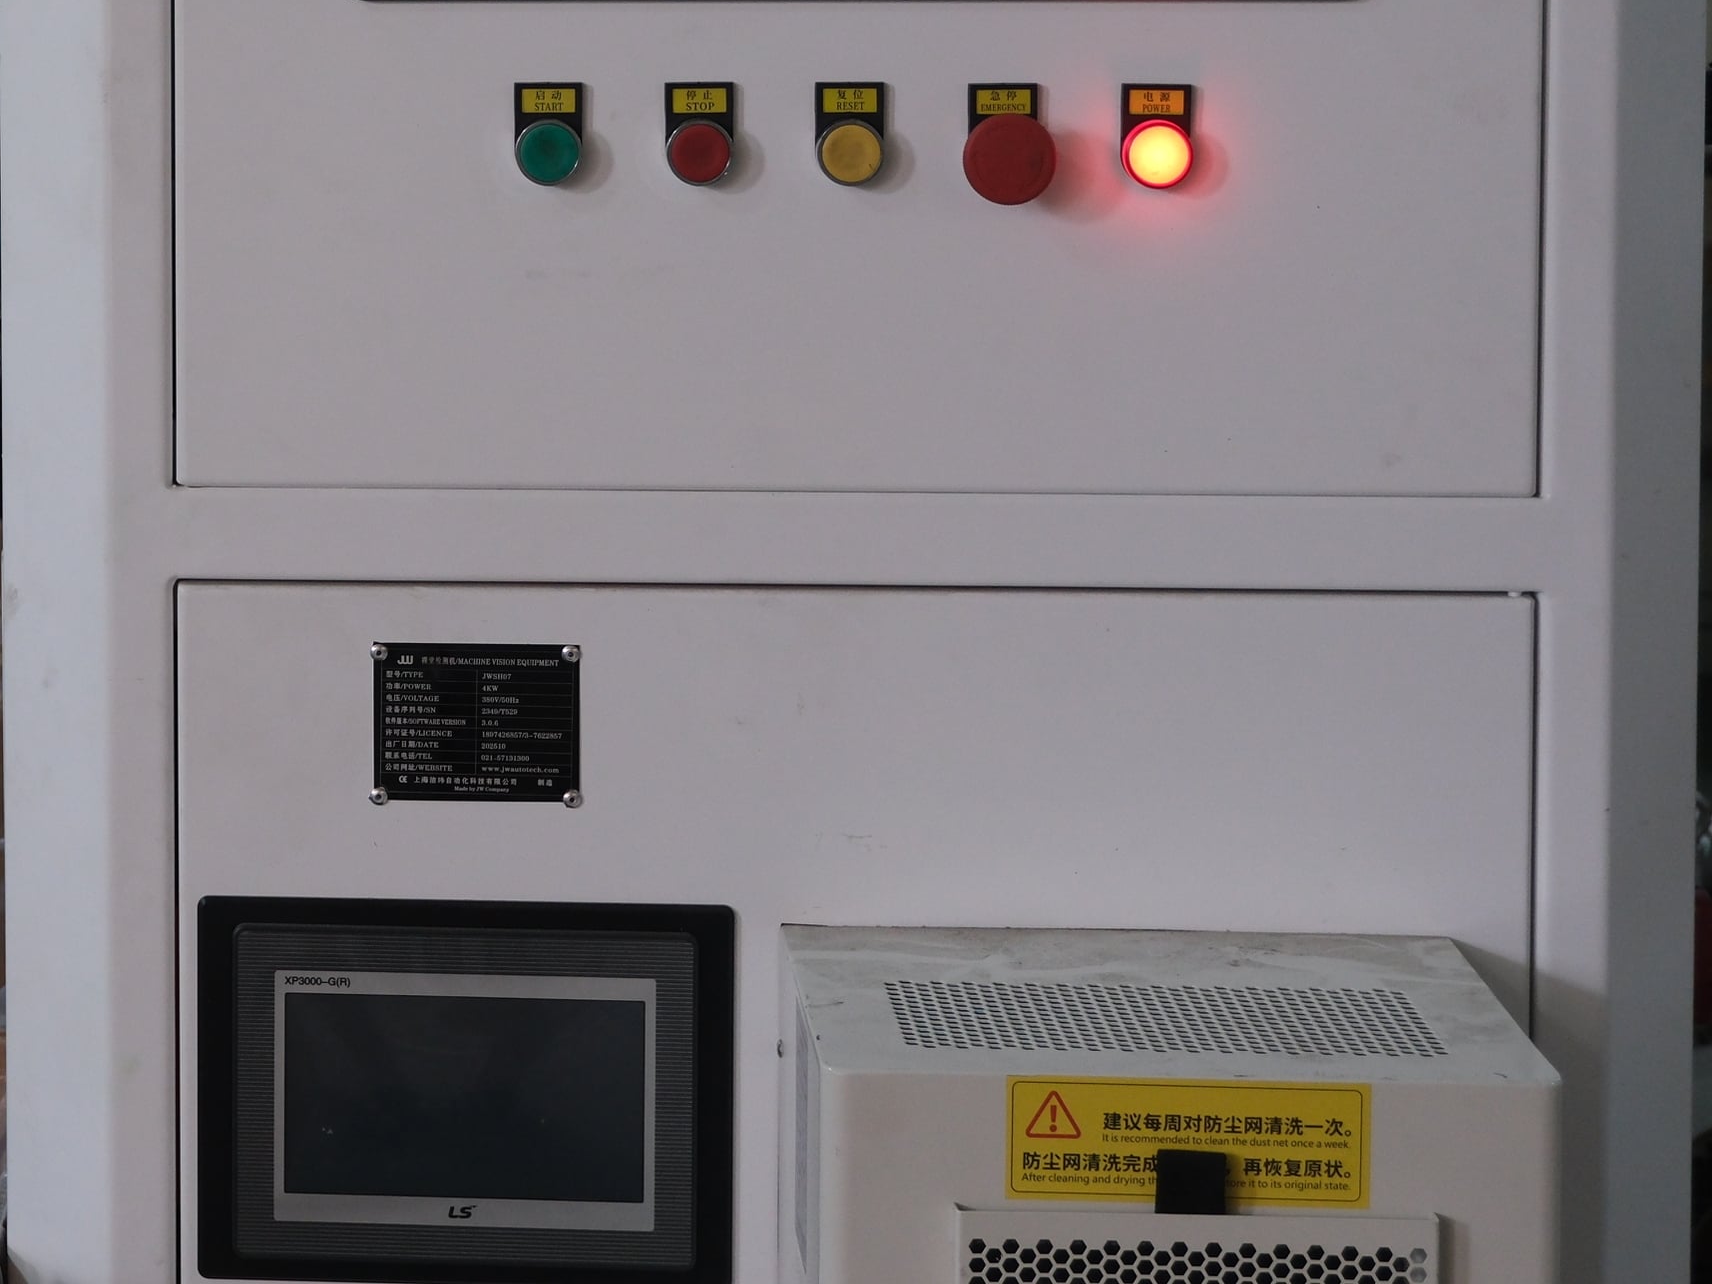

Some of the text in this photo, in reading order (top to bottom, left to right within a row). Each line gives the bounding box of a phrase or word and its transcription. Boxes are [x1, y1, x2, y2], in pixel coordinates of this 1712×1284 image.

[535, 90, 562, 102] 启动
[686, 90, 713, 101] 停止
[837, 89, 864, 100] 复位
[990, 90, 1018, 102] 急停
[1143, 91, 1171, 103] 电源
[534, 102, 564, 112] START
[685, 102, 715, 112] STOP
[836, 101, 865, 111] RESET
[980, 102, 1028, 113] EMERGENCY
[1141, 103, 1171, 113] POWER
[492, 658, 516, 666] VISION
[517, 659, 560, 667] EQUIPMENT
[1103, 1112, 1352, 1137] 建议每周对防尘网清洗一次。
[1102, 1134, 1112, 1143] It
[1113, 1134, 1119, 1143] is
[1121, 1135, 1190, 1145] recommended
[1192, 1137, 1203, 1145] to
[1204, 1136, 1230, 1146] clean
[1232, 1136, 1248, 1146] the
[1250, 1137, 1271, 1147] dust
[1273, 1138, 1289, 1148] net
[1291, 1139, 1314, 1148] once
[1021, 1173, 1046, 1182] After
[1049, 1174, 1089, 1185] cleaning
[1092, 1175, 1111, 1184] and
[1113, 1175, 1145, 1187] drying
[1248, 1179, 1255, 1188] it
[1258, 1180, 1268, 1188] to
[1270, 1180, 1282, 1189] its
[1285, 1180, 1322, 1192] original
[1324, 1182, 1351, 1191] state.
[448, 1205, 474, 1219] LS
